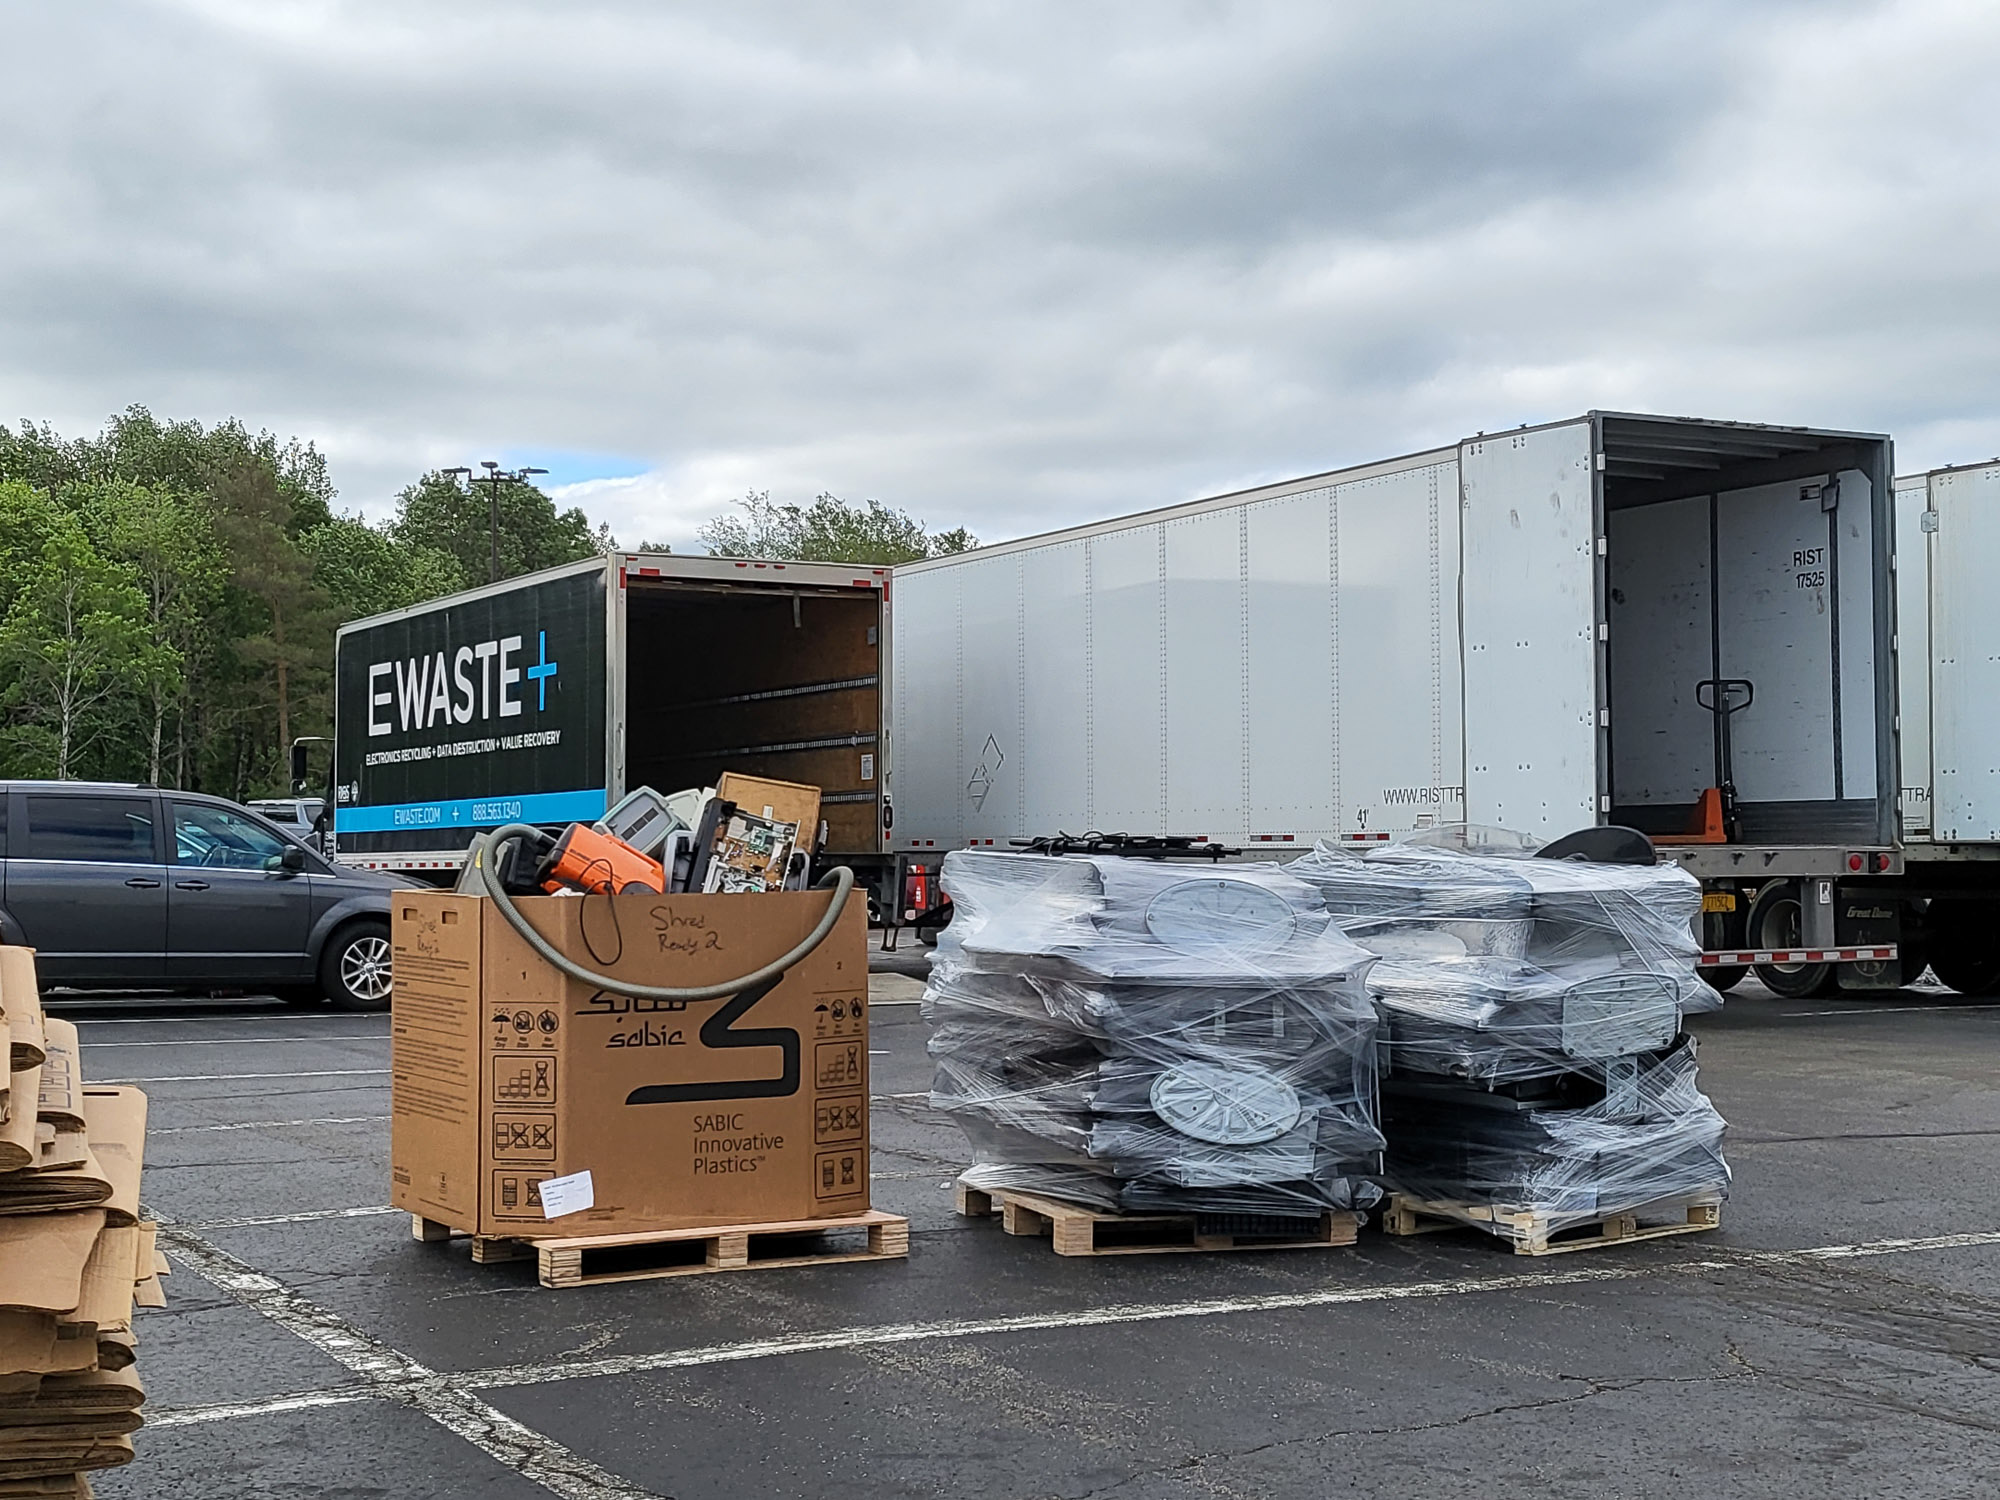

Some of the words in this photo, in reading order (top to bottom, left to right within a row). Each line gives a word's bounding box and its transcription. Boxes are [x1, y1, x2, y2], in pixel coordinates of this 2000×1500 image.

[1793, 547, 1824, 567] RIST
[1796, 571, 1825, 589] 17525
[365, 750, 401, 766] ELECTRONICS
[401, 746, 431, 762] RECYCLING
[437, 744, 453, 758] DATA
[453, 738, 496, 756] DESTRUCTION
[501, 735, 523, 751] VALUE
[523, 730, 561, 748] RECOVERY
[394, 808, 441, 825] EWASTE.COM
[472, 801, 522, 821] 888.563.1340
[650, 905, 705, 931] Shred
[658, 933, 698, 956] Ready
[705, 931, 724, 951] 2
[521, 971, 527, 980] 1
[605, 1020, 687, 1049] sabic
[693, 1113, 744, 1133] SABIC
[694, 1132, 784, 1154] Innovative
